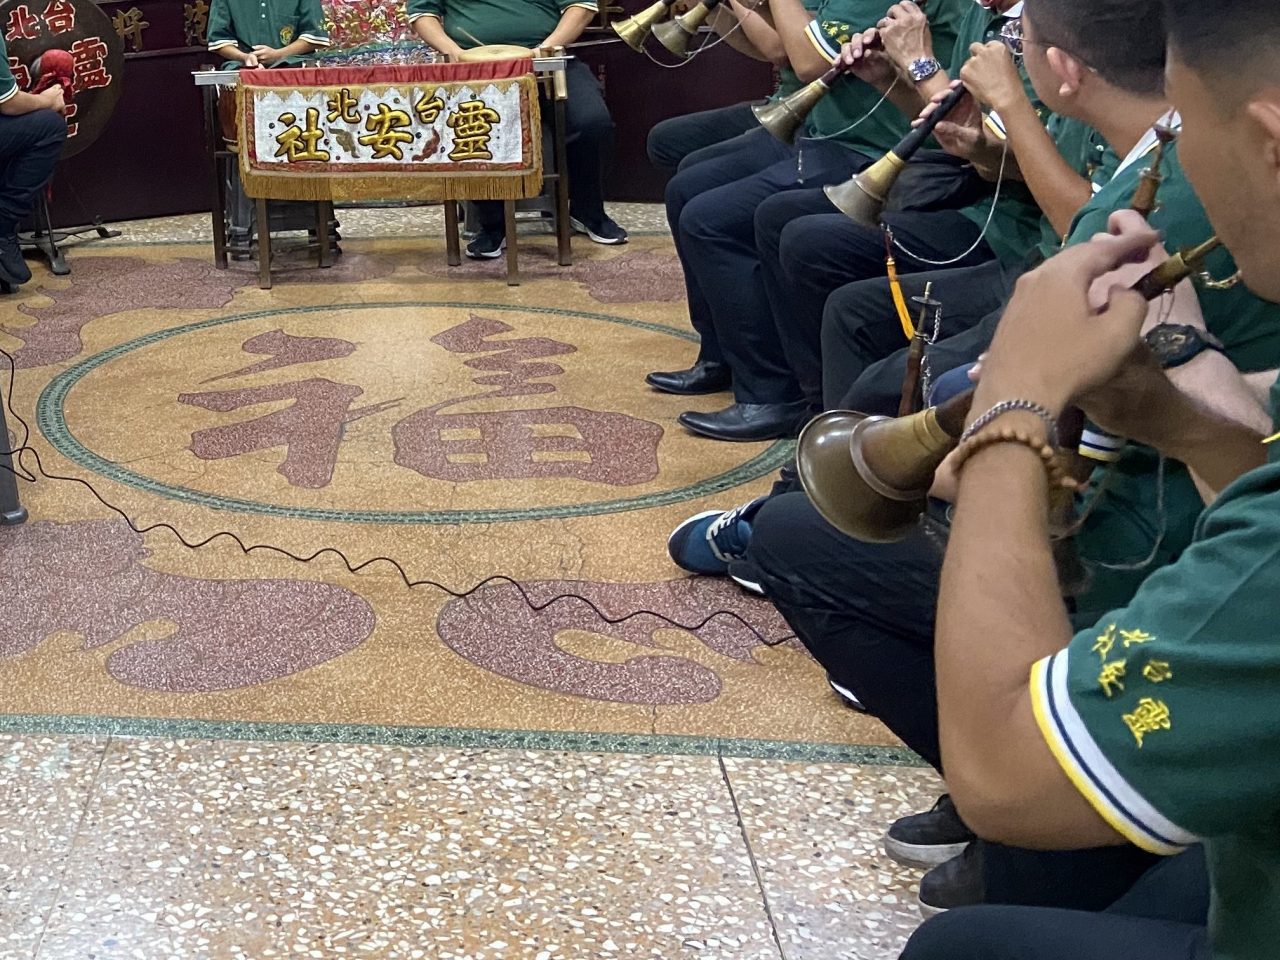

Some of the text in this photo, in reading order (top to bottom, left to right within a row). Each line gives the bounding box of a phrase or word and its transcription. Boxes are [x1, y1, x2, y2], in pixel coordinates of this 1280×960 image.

[5, 0, 76, 41] 台北
[275, 100, 501, 162] 靈安社
[326, 88, 445, 125] 台北
[178, 313, 665, 489] 福
